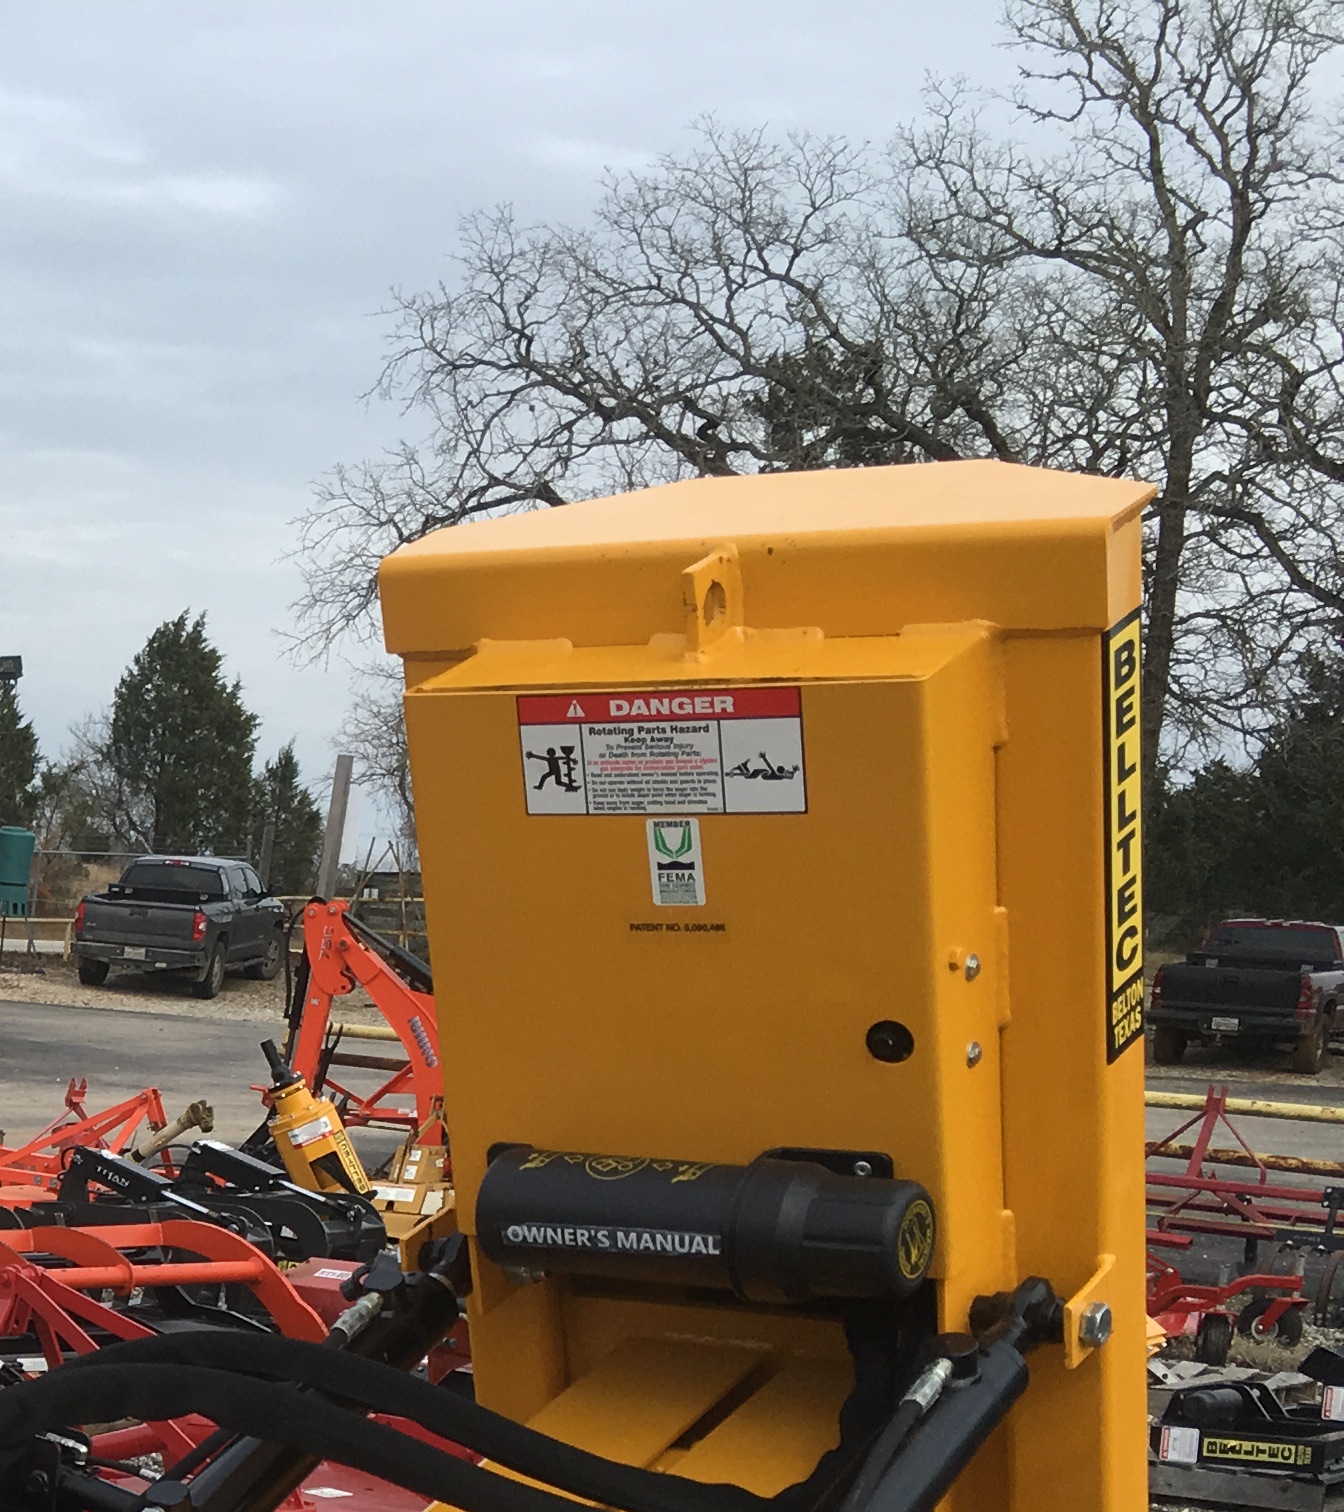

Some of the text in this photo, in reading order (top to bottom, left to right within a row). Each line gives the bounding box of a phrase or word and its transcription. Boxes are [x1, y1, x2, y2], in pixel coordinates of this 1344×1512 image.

[610, 697, 734, 716] DANGER
[589, 724, 709, 737] Rotating Parts Hazard
[1114, 639, 1139, 972] BELLTEC
[658, 872, 696, 882] FEMA
[1112, 976, 1144, 1026] BELTON
[1114, 1005, 1142, 1050] TEXAS
[96, 1165, 130, 1188] TITAN
[506, 1225, 721, 1256] OWNER'S MANUAL
